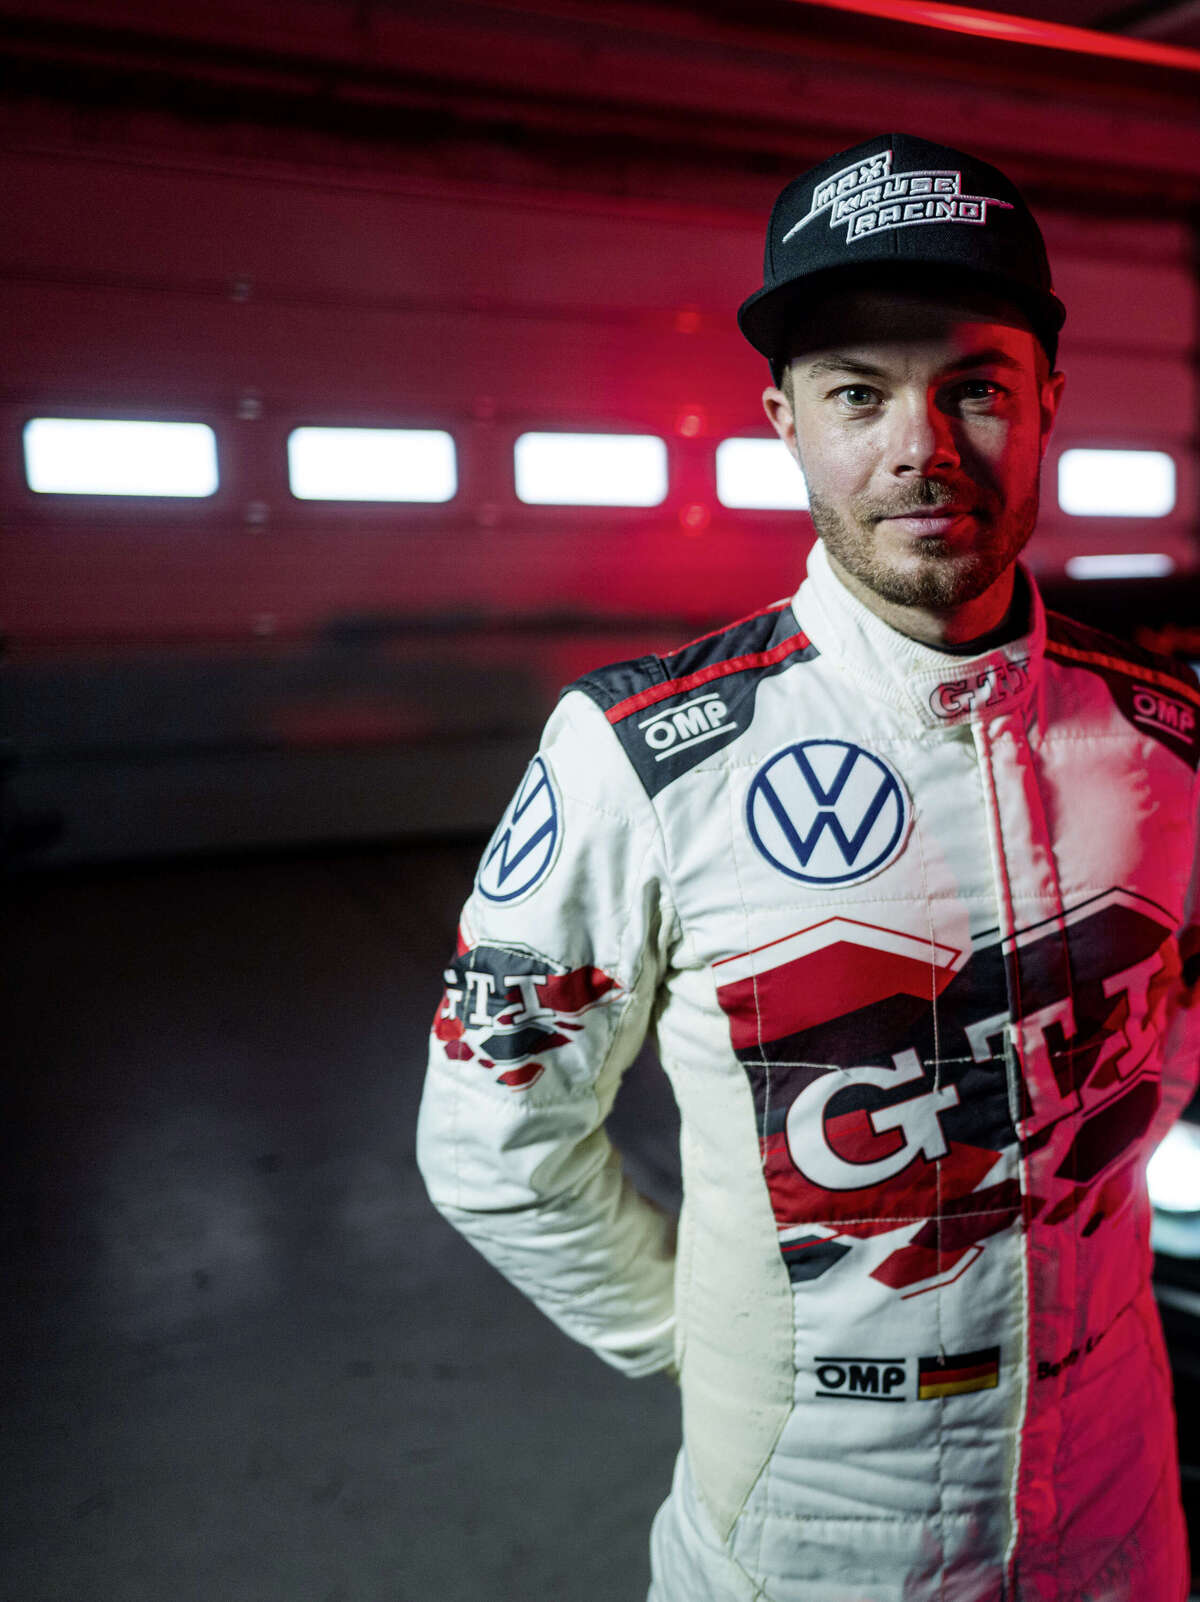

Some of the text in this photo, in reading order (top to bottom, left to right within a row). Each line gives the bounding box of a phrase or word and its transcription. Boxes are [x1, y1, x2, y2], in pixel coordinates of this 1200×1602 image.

[815, 157, 884, 205] MAX
[836, 176, 957, 218] KRUSE
[854, 200, 980, 234] RACING
[644, 699, 729, 750] OMP
[1132, 693, 1196, 732] OMP
[785, 951, 1166, 1192] GTI
[815, 1364, 907, 1395] OMP
